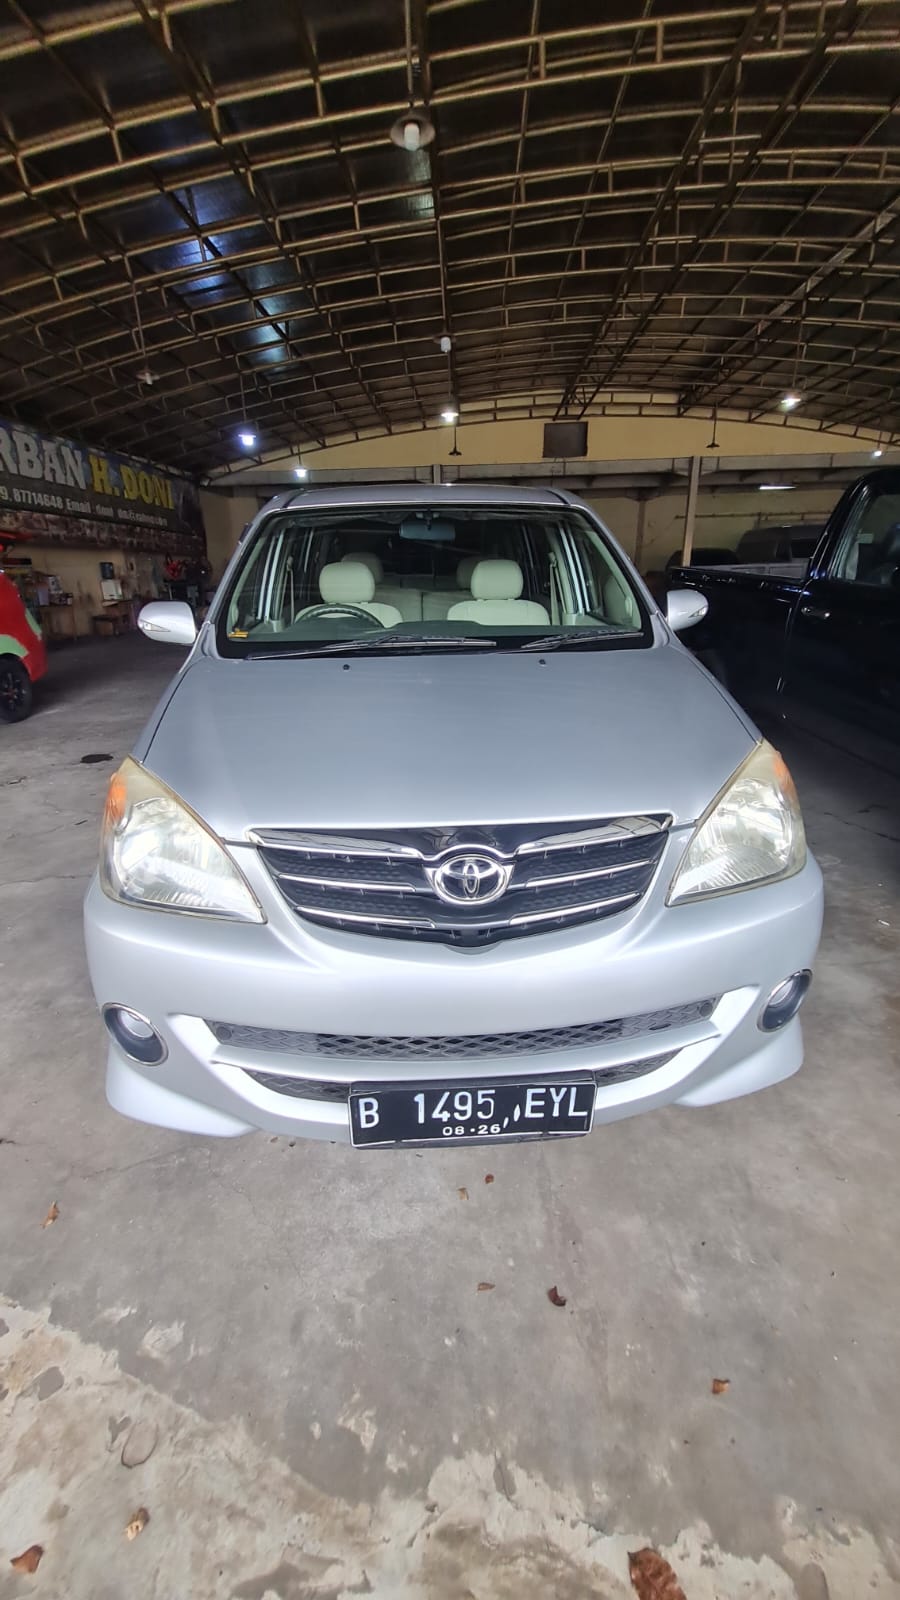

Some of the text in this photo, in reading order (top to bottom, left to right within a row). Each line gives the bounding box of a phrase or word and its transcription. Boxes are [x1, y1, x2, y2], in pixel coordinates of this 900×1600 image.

[0, 427, 86, 490] RBAN
[120, 465, 175, 510] DONI
[358, 1086, 588, 1129] B 1495 EYL
